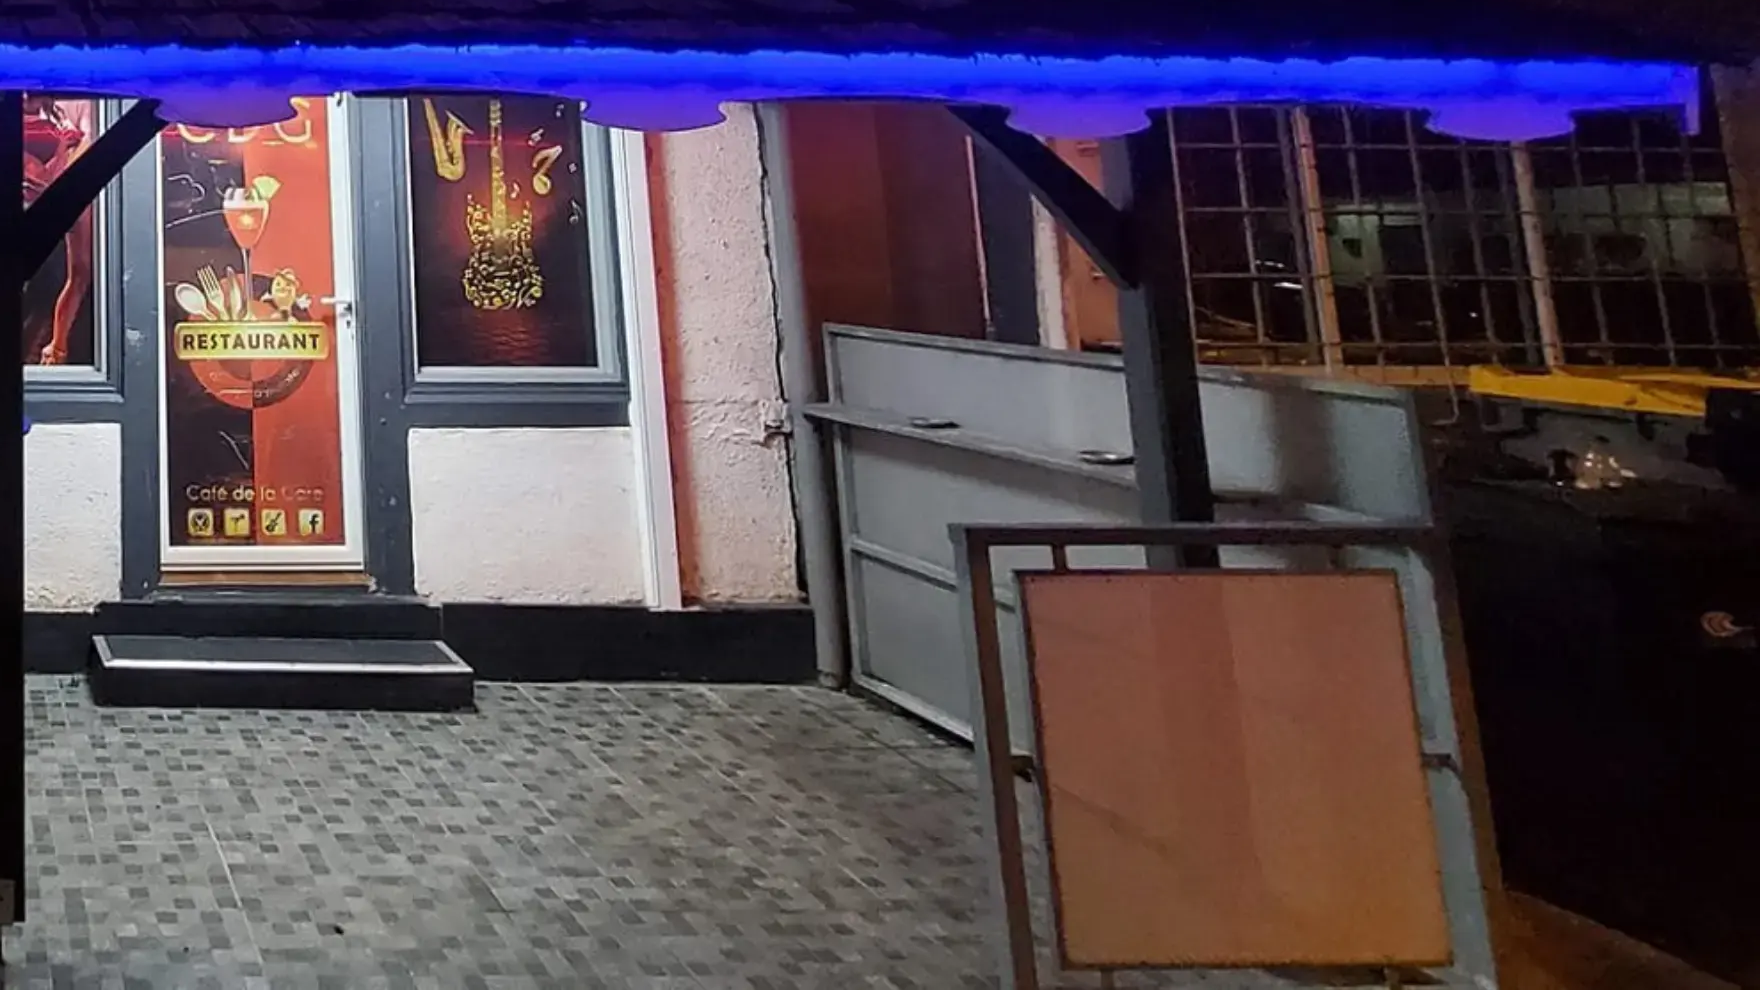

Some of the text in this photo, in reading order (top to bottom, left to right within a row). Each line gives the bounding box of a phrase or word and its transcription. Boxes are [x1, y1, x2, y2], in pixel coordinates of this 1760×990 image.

[183, 333, 320, 350] RESTAURANT
[186, 484, 228, 501] Café
[233, 485, 255, 501] de
[260, 485, 276, 501] la
